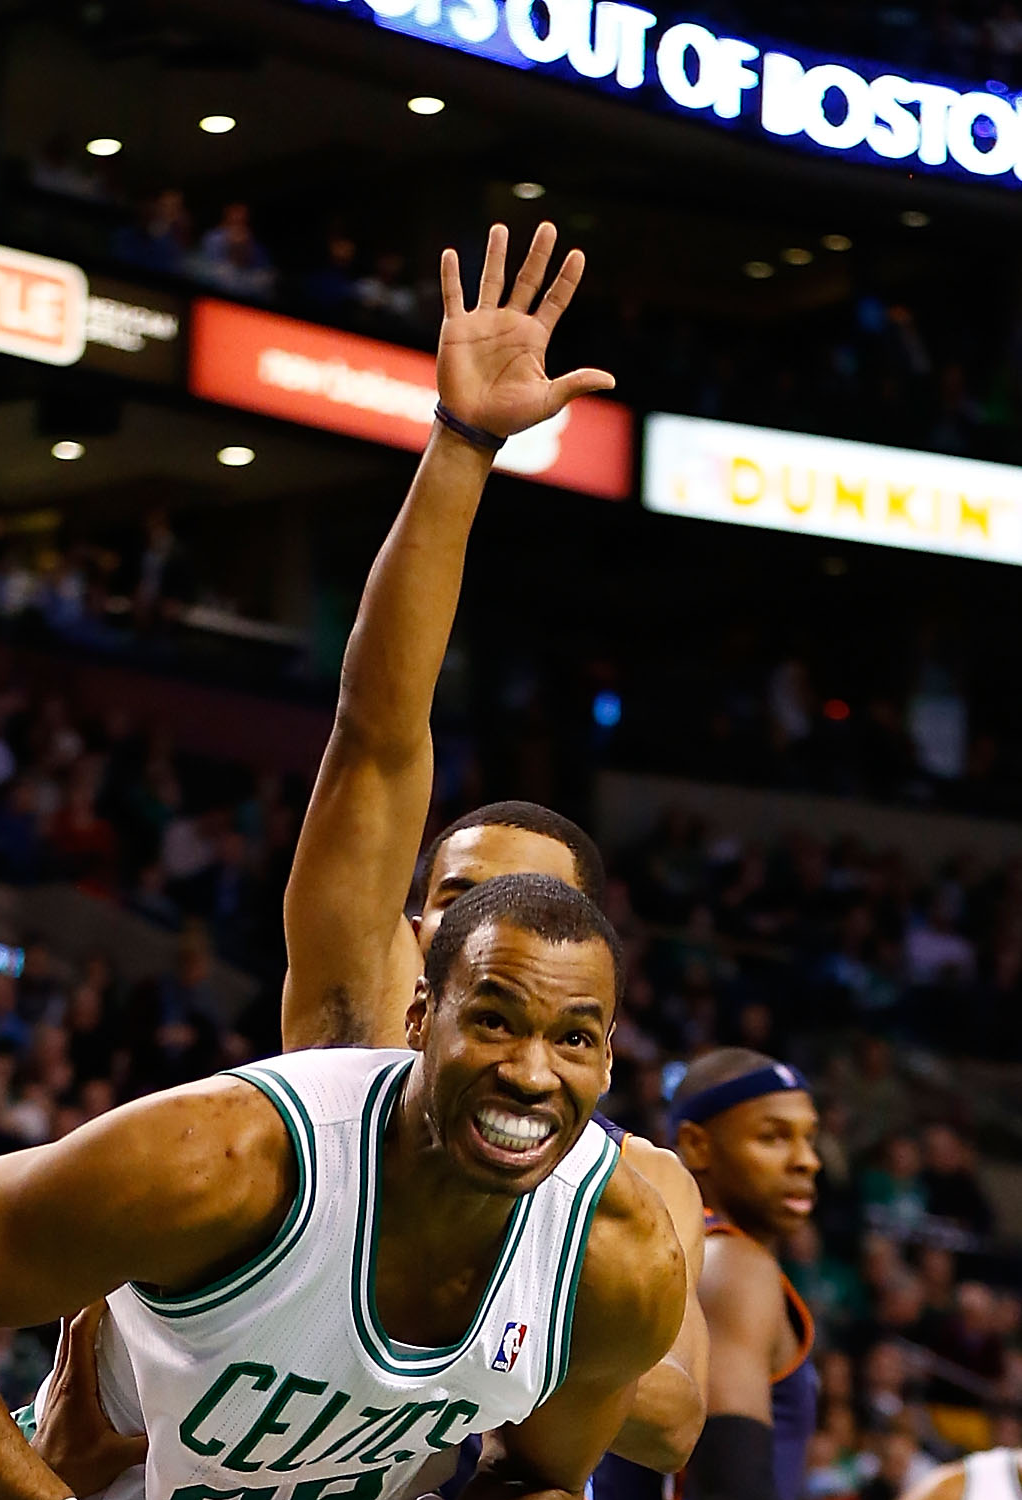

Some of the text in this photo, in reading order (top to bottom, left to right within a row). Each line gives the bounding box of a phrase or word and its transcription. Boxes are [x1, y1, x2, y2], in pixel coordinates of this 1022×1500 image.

[505, 0, 657, 88] OUT
[656, 23, 759, 118] OF
[761, 52, 1022, 182] BOSTO
